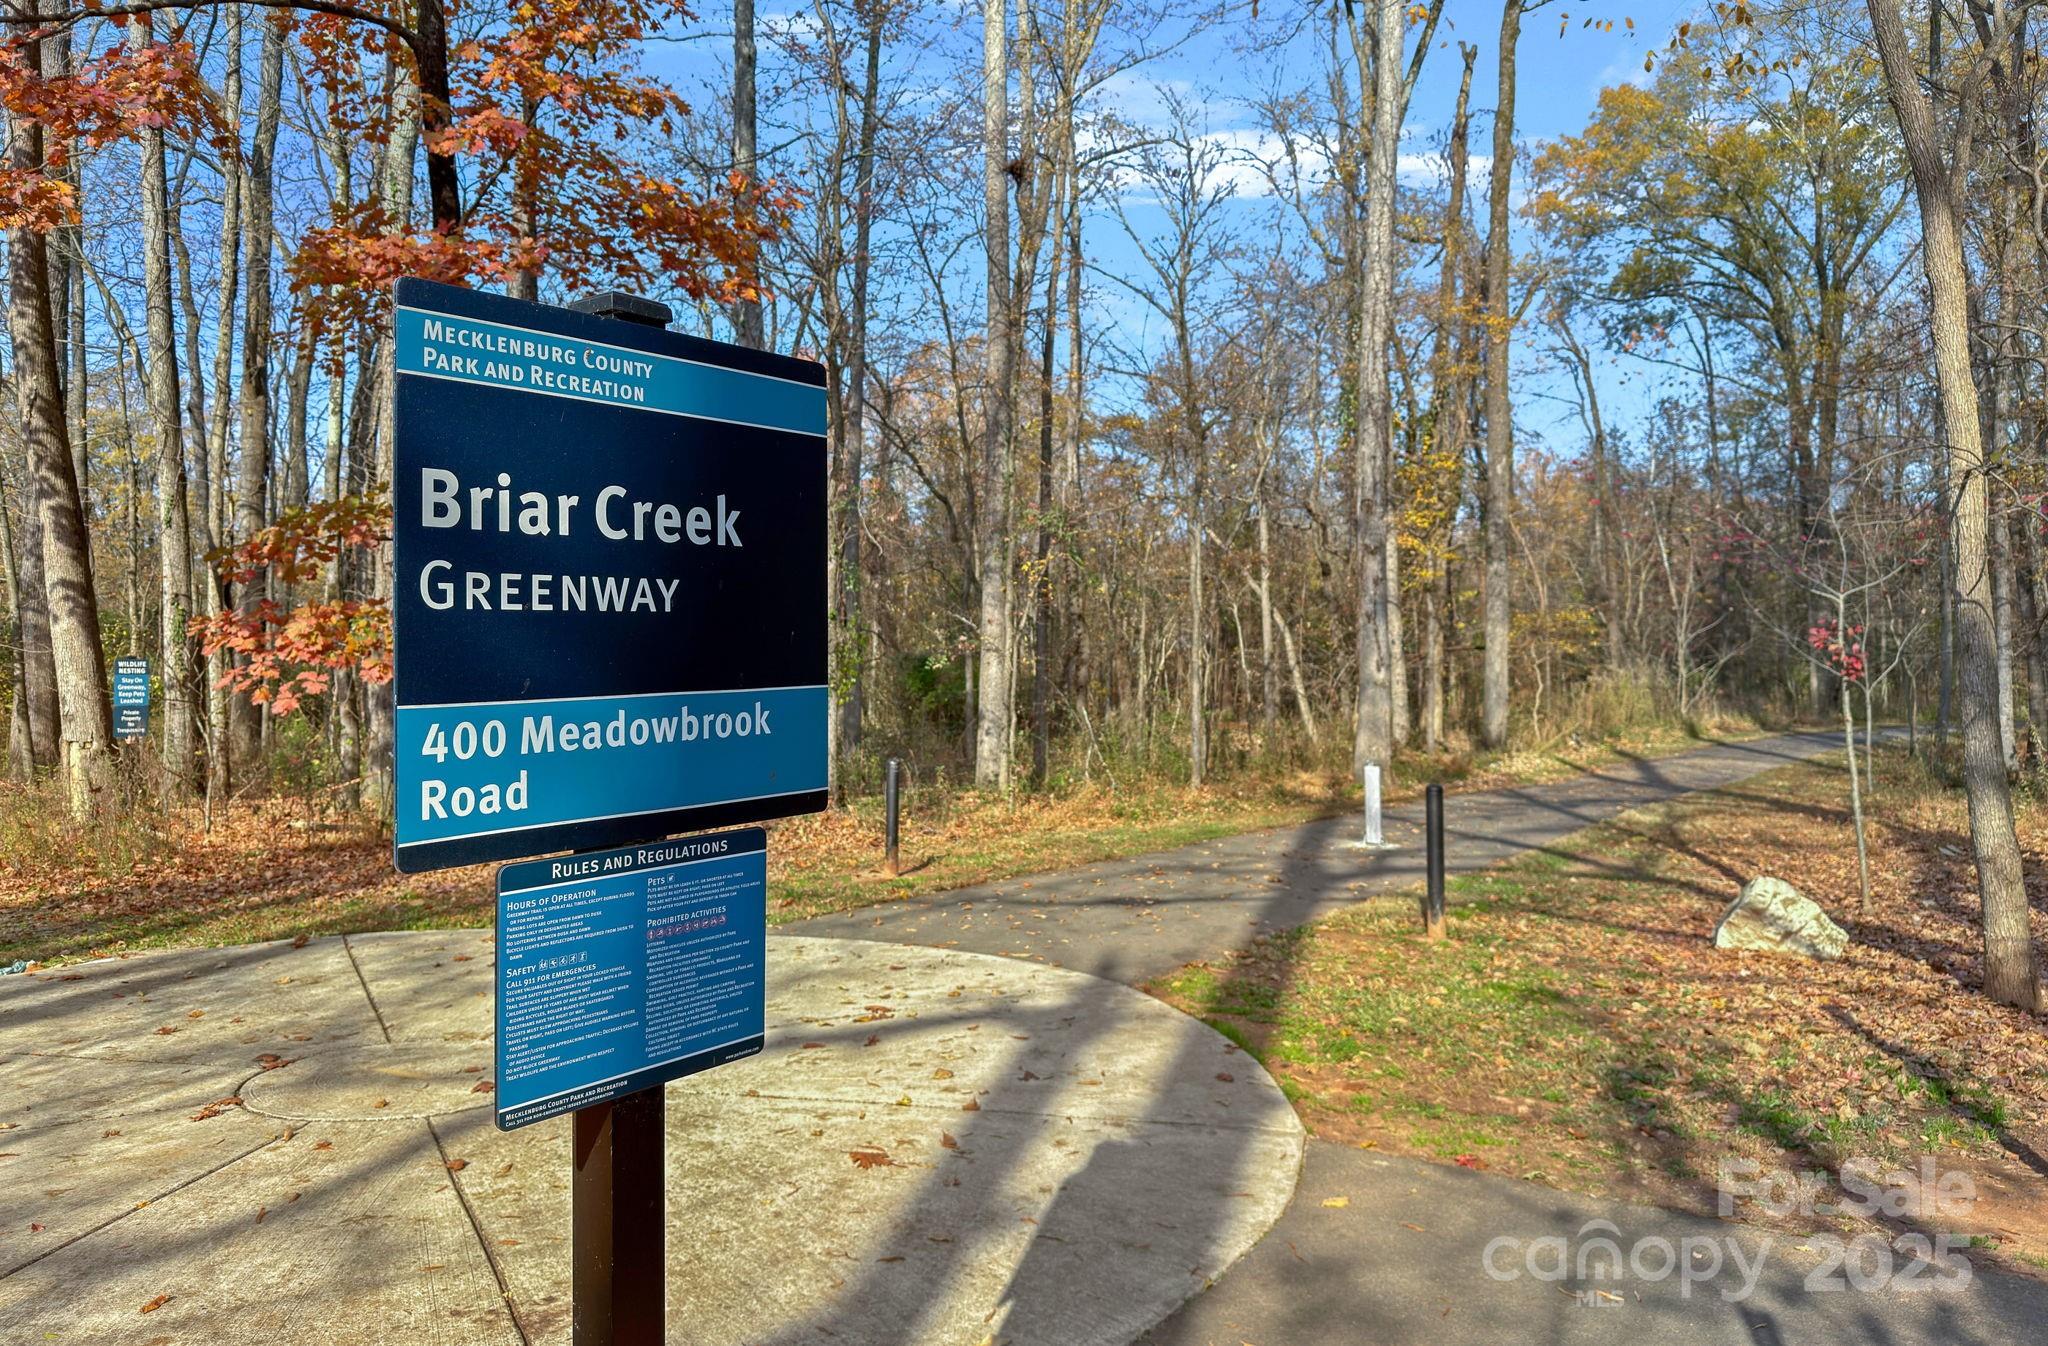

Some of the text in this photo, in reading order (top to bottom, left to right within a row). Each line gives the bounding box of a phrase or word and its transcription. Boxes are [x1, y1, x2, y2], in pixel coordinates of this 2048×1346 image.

[423, 319, 653, 379] MECKLENBURG COUNTY
[423, 347, 645, 403] PARK AND RECREATION
[421, 468, 743, 547] Briar Creek
[420, 560, 680, 612] GREENWAY
[422, 701, 771, 764] 400 Meadowbrook
[422, 770, 528, 821] Road
[551, 839, 727, 879] RULES AND REGULATIONS
[506, 889, 596, 911] HOURS OF OPERATION
[647, 876, 665, 886] PETS
[647, 904, 726, 928] PROHIBITED ACTIVITIES
[506, 964, 535, 978] SAFETY
[506, 962, 596, 989] CALL 911 FOR EMERGENCIES
[505, 1080, 627, 1121] MECKLENBURG COUNTY PARK AND RECREATION
